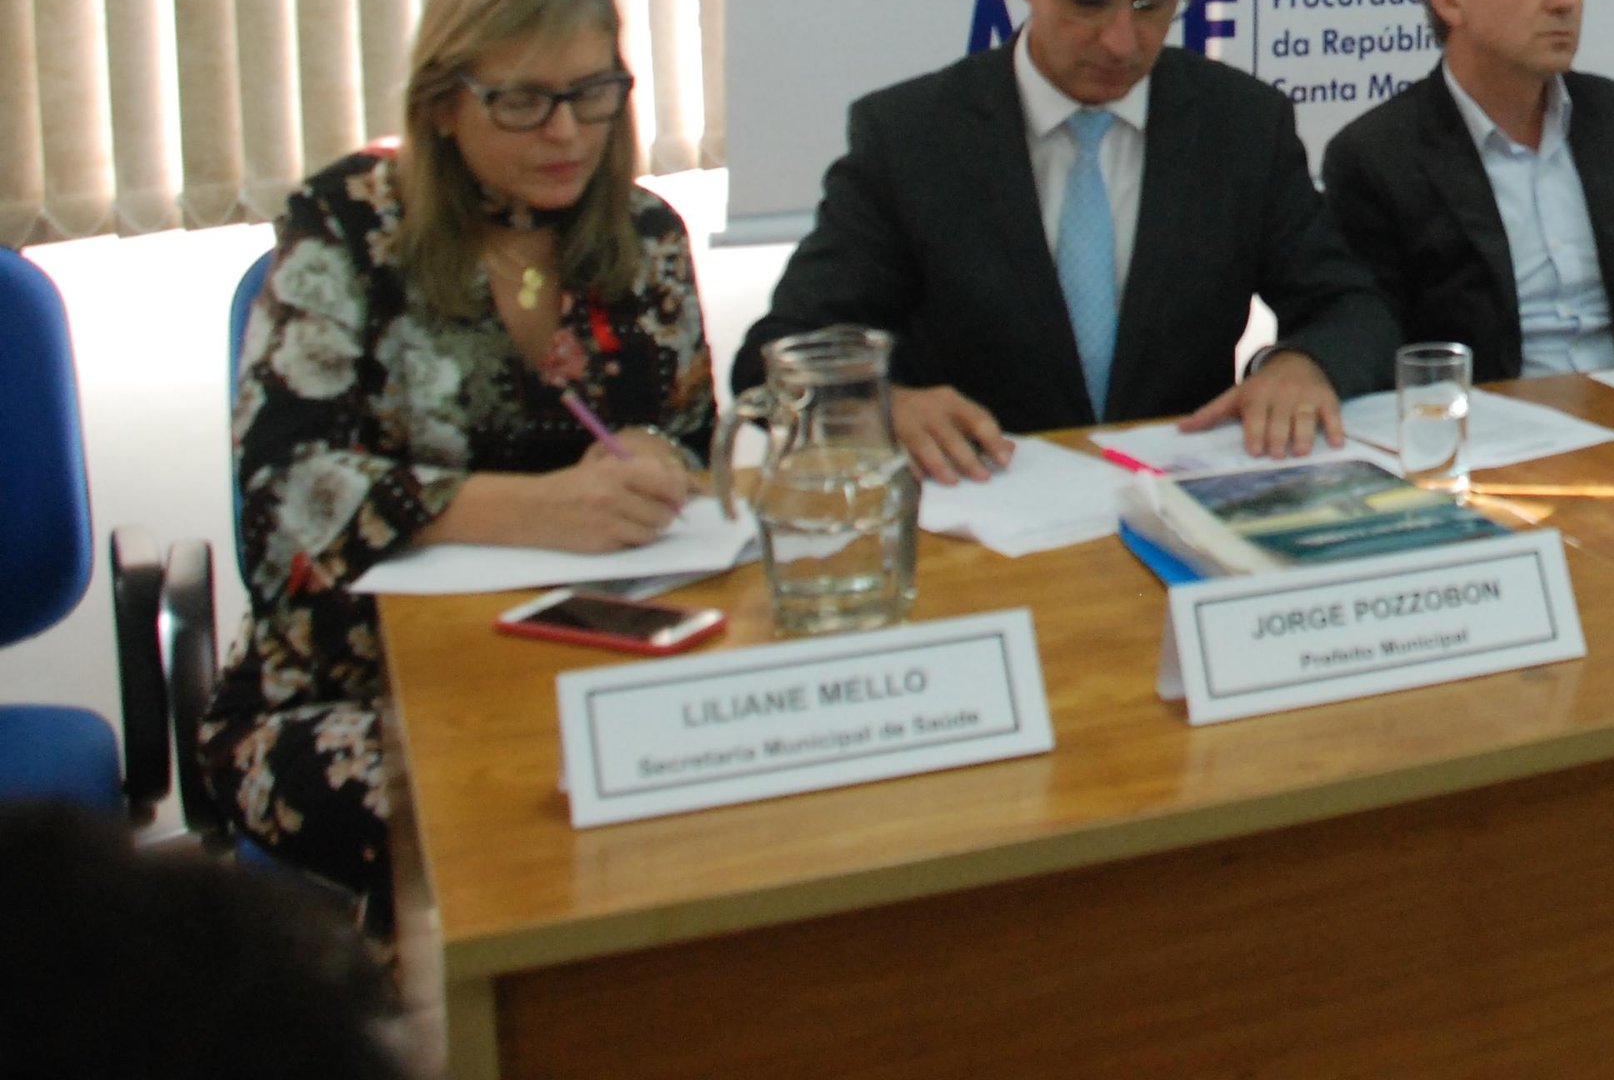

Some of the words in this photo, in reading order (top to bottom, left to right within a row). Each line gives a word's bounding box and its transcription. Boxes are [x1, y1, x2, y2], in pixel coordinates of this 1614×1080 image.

[1272, 29, 1310, 58] da
[1322, 24, 1434, 61] Repúbli
[1252, 604, 1346, 640] JORGE
[1355, 580, 1500, 622] POZZOBON
[682, 687, 808, 728] LILIANE
[818, 670, 928, 705] MELLO
